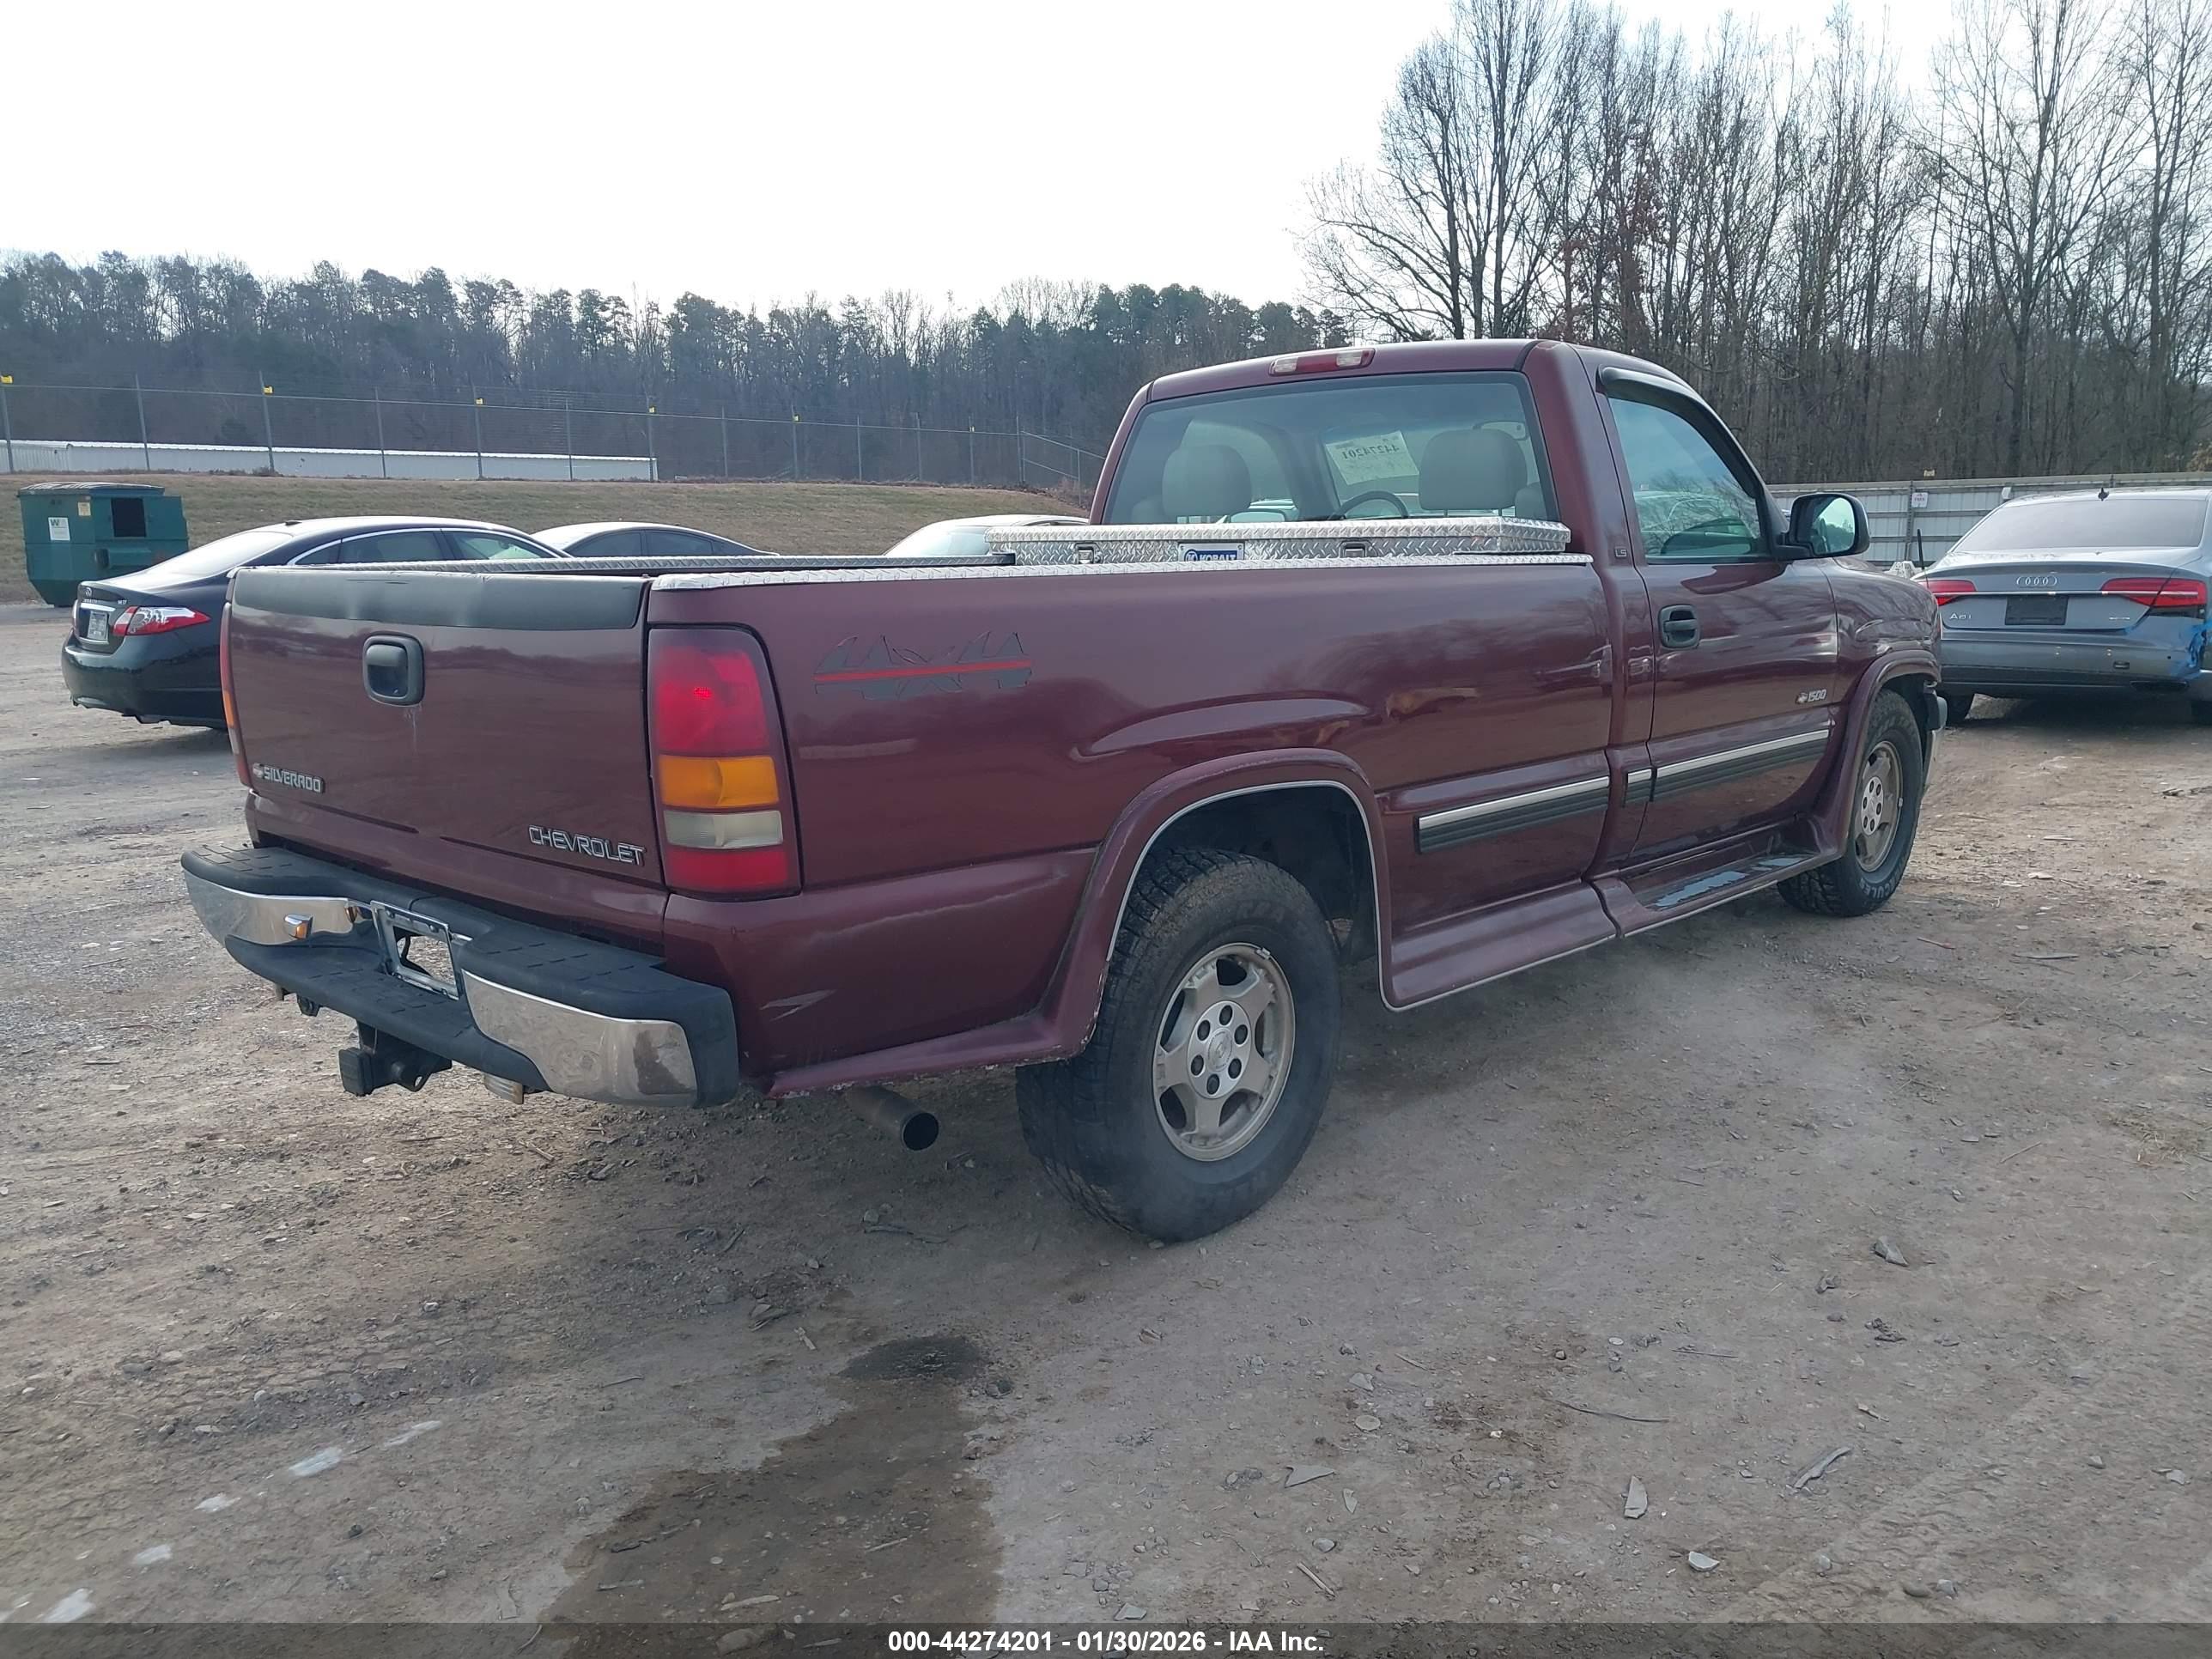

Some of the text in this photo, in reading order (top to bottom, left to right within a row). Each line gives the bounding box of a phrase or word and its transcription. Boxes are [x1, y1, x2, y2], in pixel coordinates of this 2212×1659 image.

[1615, 549, 1627, 557] LS
[1807, 688, 1827, 702] 1500
[263, 766, 322, 793] SILVERADO
[527, 824, 647, 866] CHEVROLET
